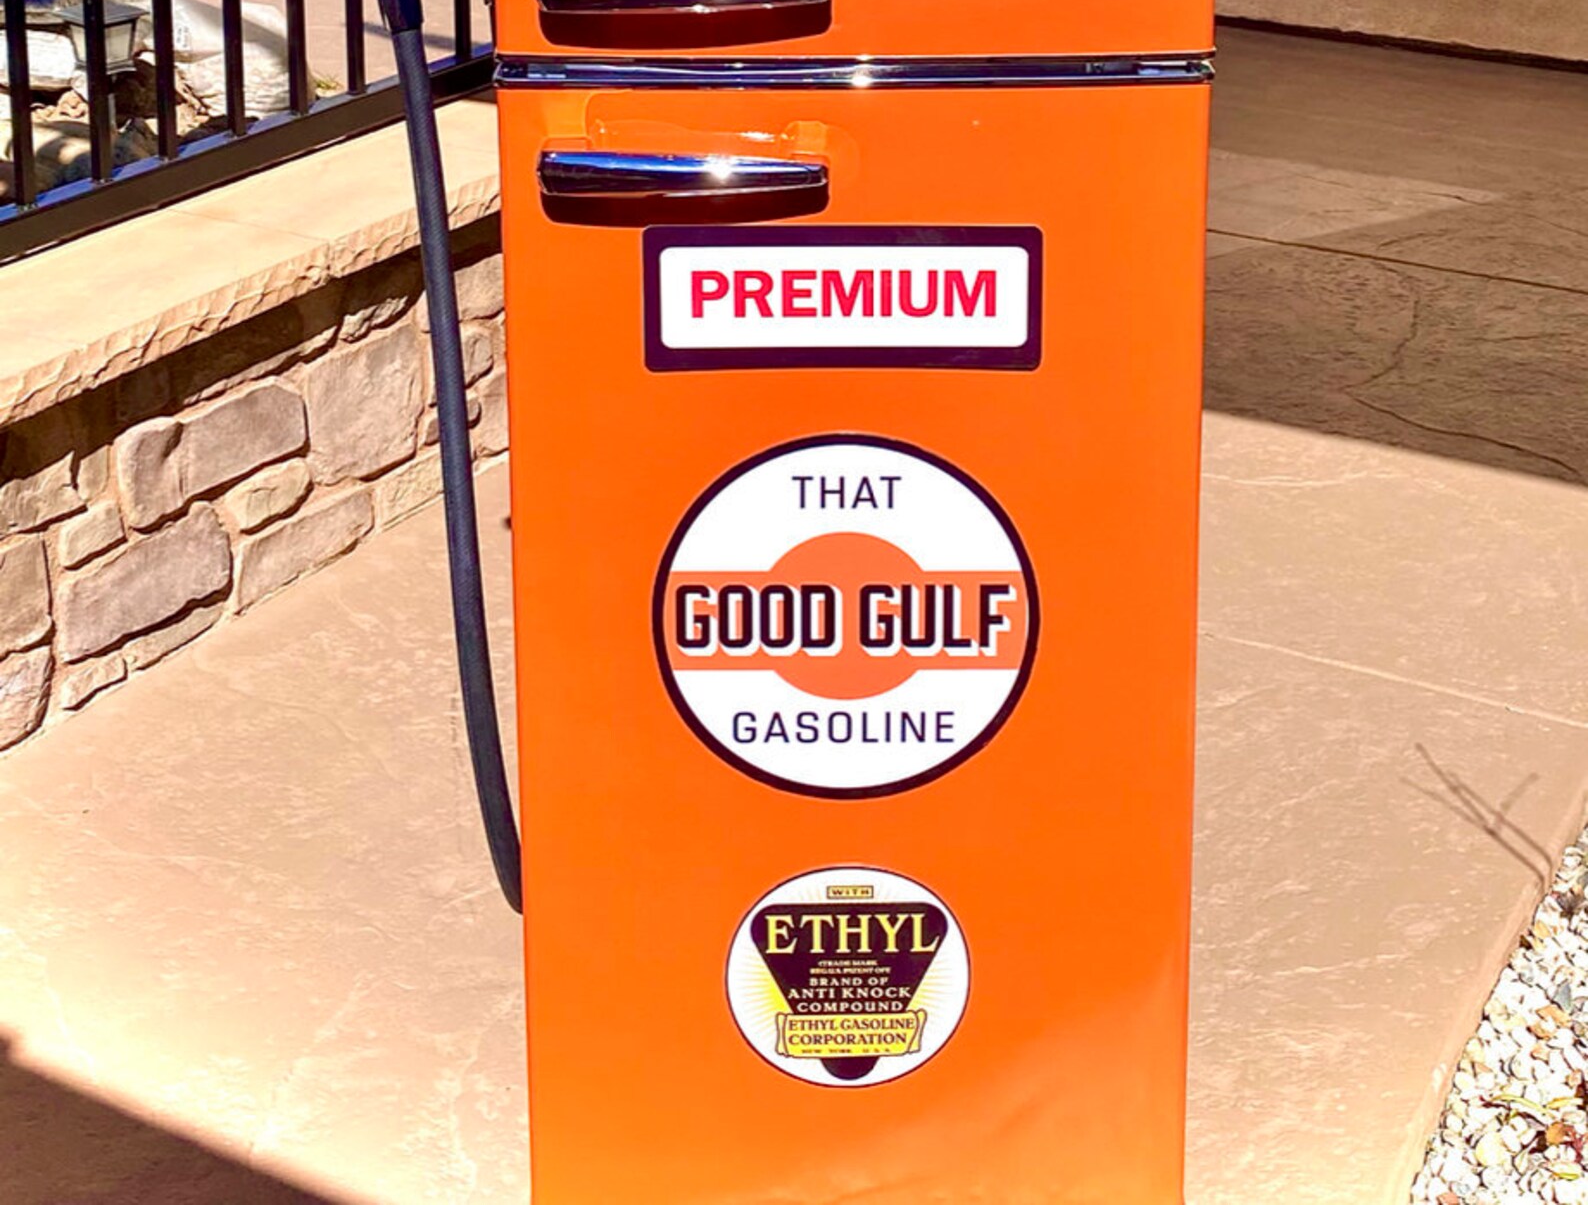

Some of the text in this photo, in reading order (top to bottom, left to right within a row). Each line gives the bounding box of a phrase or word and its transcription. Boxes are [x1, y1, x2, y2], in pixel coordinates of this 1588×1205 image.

[690, 270, 997, 318] PREMIUM
[791, 476, 902, 509] THAT
[674, 584, 1018, 657] GOOD GULF
[731, 711, 955, 744] GASOLINE
[765, 913, 940, 954] ETHYL
[787, 987, 911, 999] ANTI KNOCK
[809, 977, 889, 986] BRAND OF
[796, 1001, 904, 1013] COMPOUND
[788, 1018, 915, 1031] ETHYL GASOLINE
[788, 1033, 907, 1045] CORPORATION
